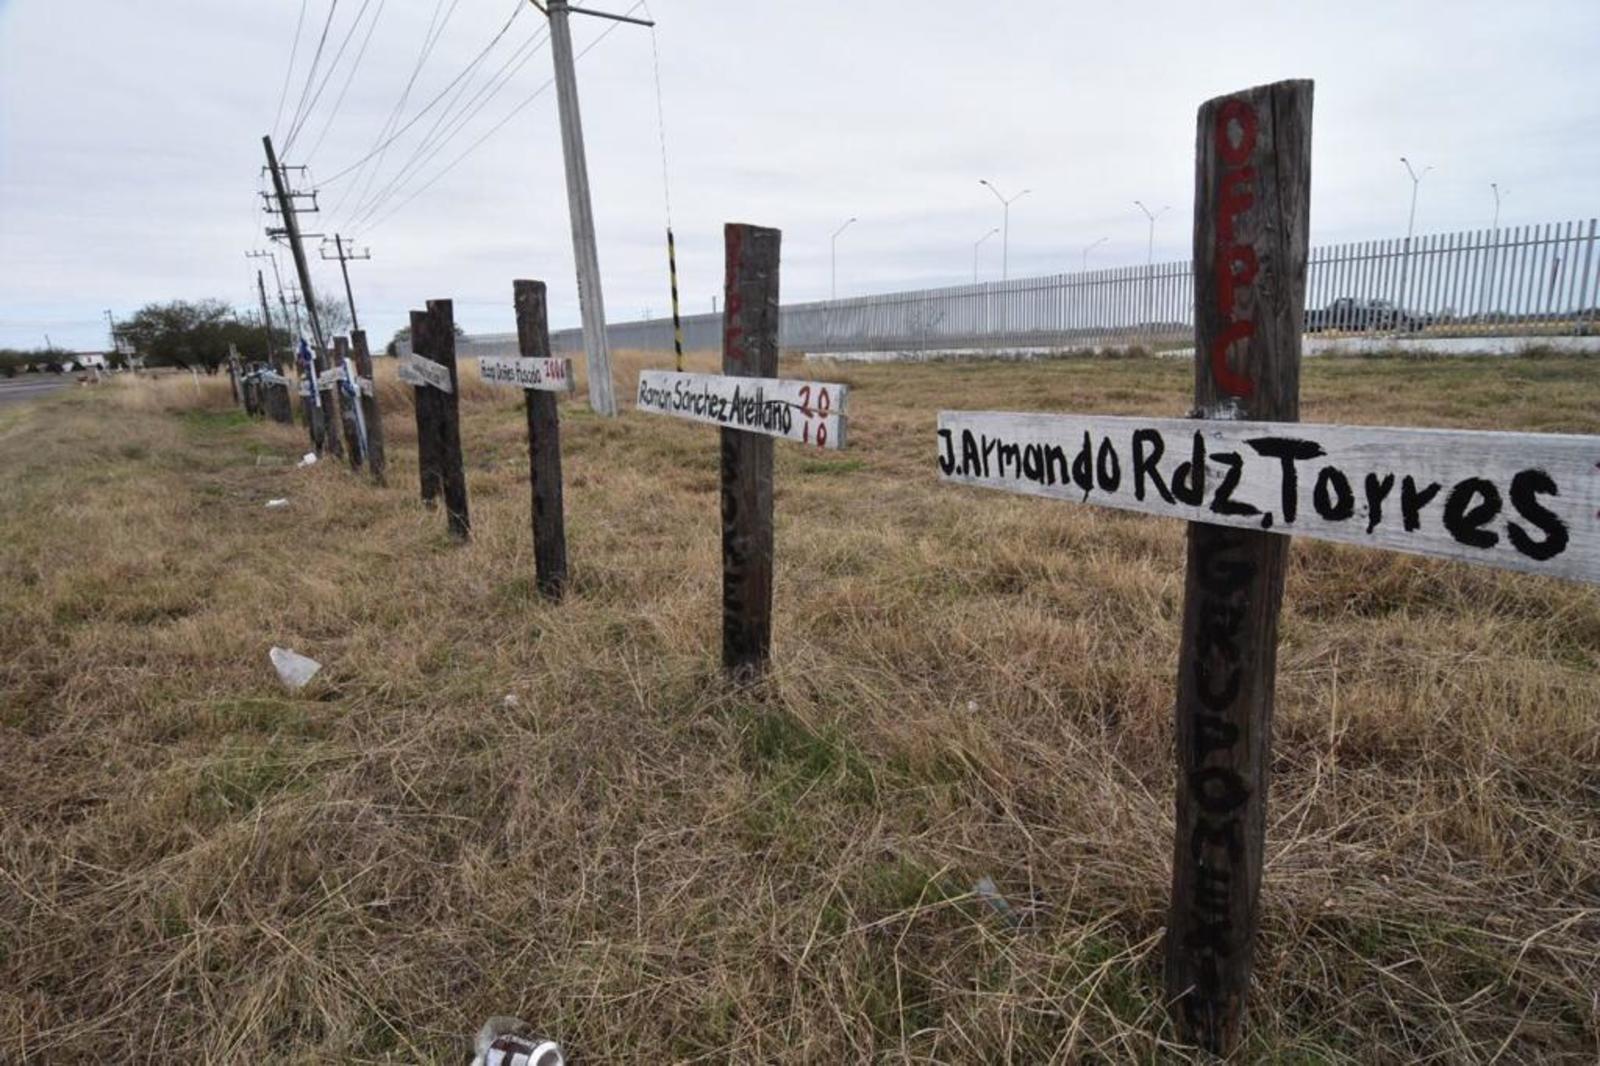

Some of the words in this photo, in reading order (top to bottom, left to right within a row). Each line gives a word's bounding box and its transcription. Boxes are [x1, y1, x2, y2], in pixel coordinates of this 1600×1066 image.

[639, 377, 672, 410] Ramón
[673, 379, 728, 422] Sánchez
[730, 385, 792, 435] Arellano
[798, 384, 831, 419] 20
